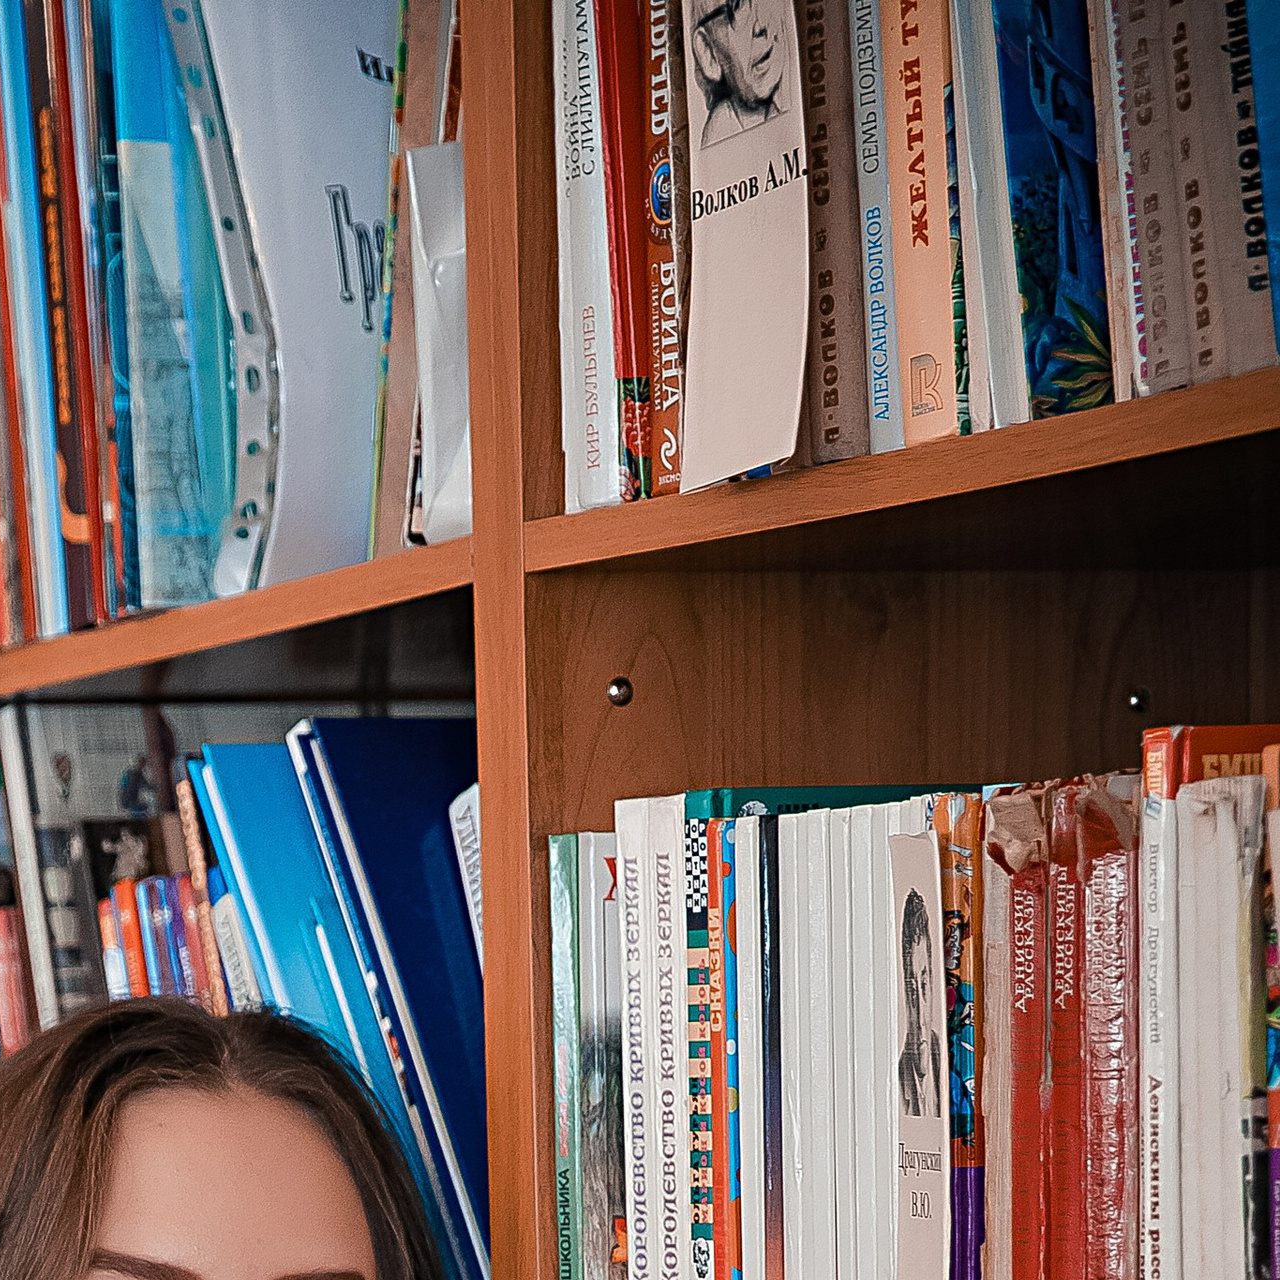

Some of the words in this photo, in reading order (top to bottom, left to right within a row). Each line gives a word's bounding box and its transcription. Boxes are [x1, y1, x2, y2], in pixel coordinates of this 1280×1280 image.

[805, 0, 827, 110] ПОДЗЕ
[1172, 21, 1192, 113] СЕМЬ
[692, 176, 759, 221] Волков
[764, 147, 808, 193] А.М.
[810, 123, 832, 204] СЕМЬ
[860, 110, 880, 174] СЕМЬ
[899, 55, 929, 248] ЖЕЛТЫЙ
[865, 206, 885, 294] ВОЛКОВ
[581, 305, 599, 416] БУЛЫЧЕВ
[651, 281, 662, 412] ЛИЛИПУТАМИ
[869, 299, 889, 421] АЛЕКСАНДР
[586, 423, 601, 470] КИР
[623, 856, 640, 962] ЗЕРКАЛ
[655, 852, 672, 958] ЗЕРКАЛ
[1146, 843, 1159, 914] Виктор
[708, 906, 722, 1033] СКАЗКИ
[1054, 865, 1068, 1010] ДЕНИСКИНЫ
[1064, 882, 1076, 996] РАССКАЗЫ
[1147, 926, 1162, 1044] Драгунский
[626, 969, 644, 1084] КРИВЫХ
[658, 965, 675, 1081] КРИВЫХ
[1147, 1075, 1163, 1221] Денискины
[557, 1168, 572, 1280] ШКОЛЬНИКА
[911, 1191, 932, 1219] В.Ю.
